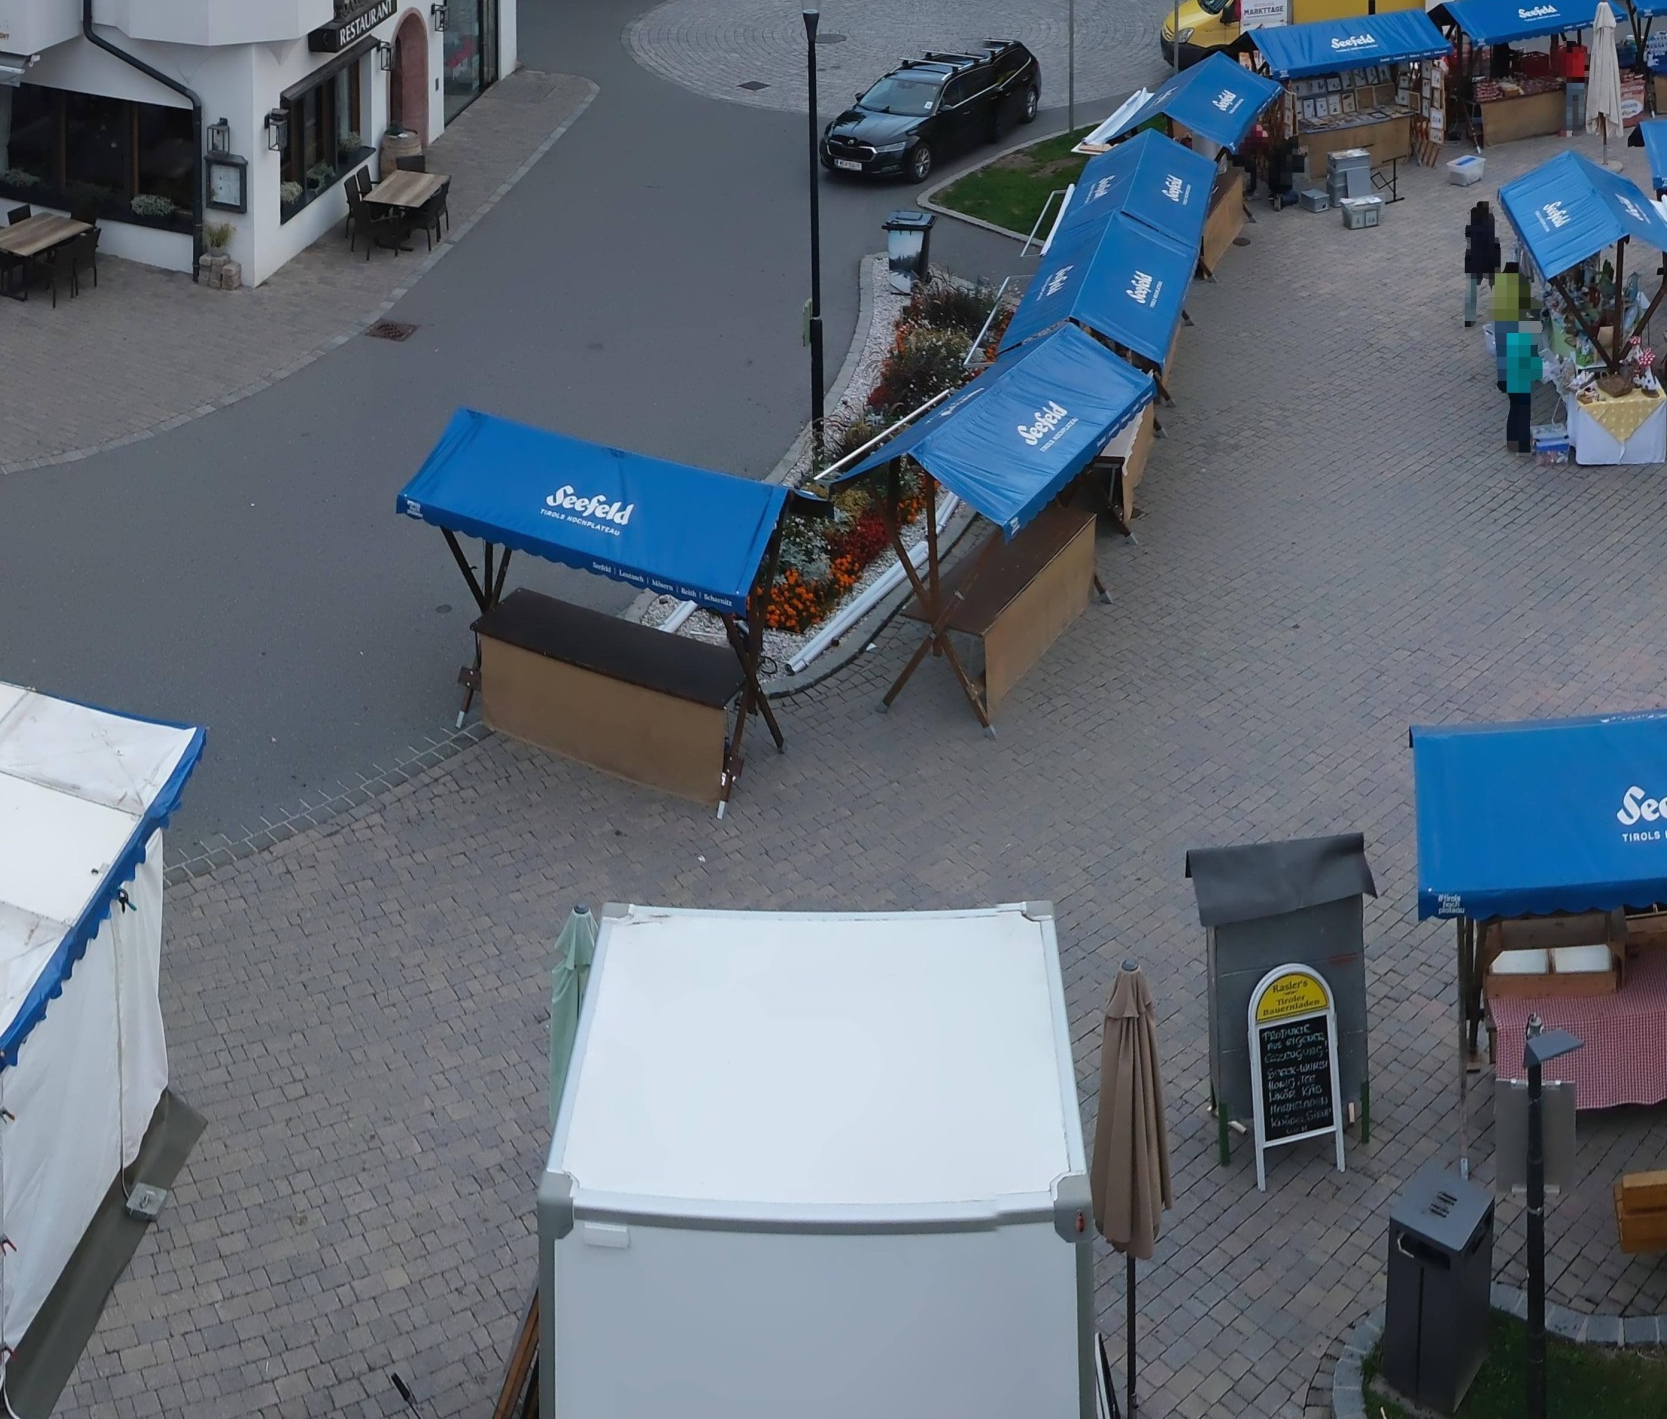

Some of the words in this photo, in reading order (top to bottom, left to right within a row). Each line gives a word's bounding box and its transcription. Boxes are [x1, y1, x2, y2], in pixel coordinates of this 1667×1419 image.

[1243, 5, 1284, 15] MARKTTAGE
[1518, 4, 1558, 18] Seefeld
[1330, 34, 1376, 50] Seefeld
[546, 484, 634, 525] Seefeld
[540, 507, 565, 522] TIROLS
[1621, 829, 1661, 843] TIROLS
[1276, 994, 1306, 1006] Tiroler
[1262, 999, 1320, 1016] Bauernladen
